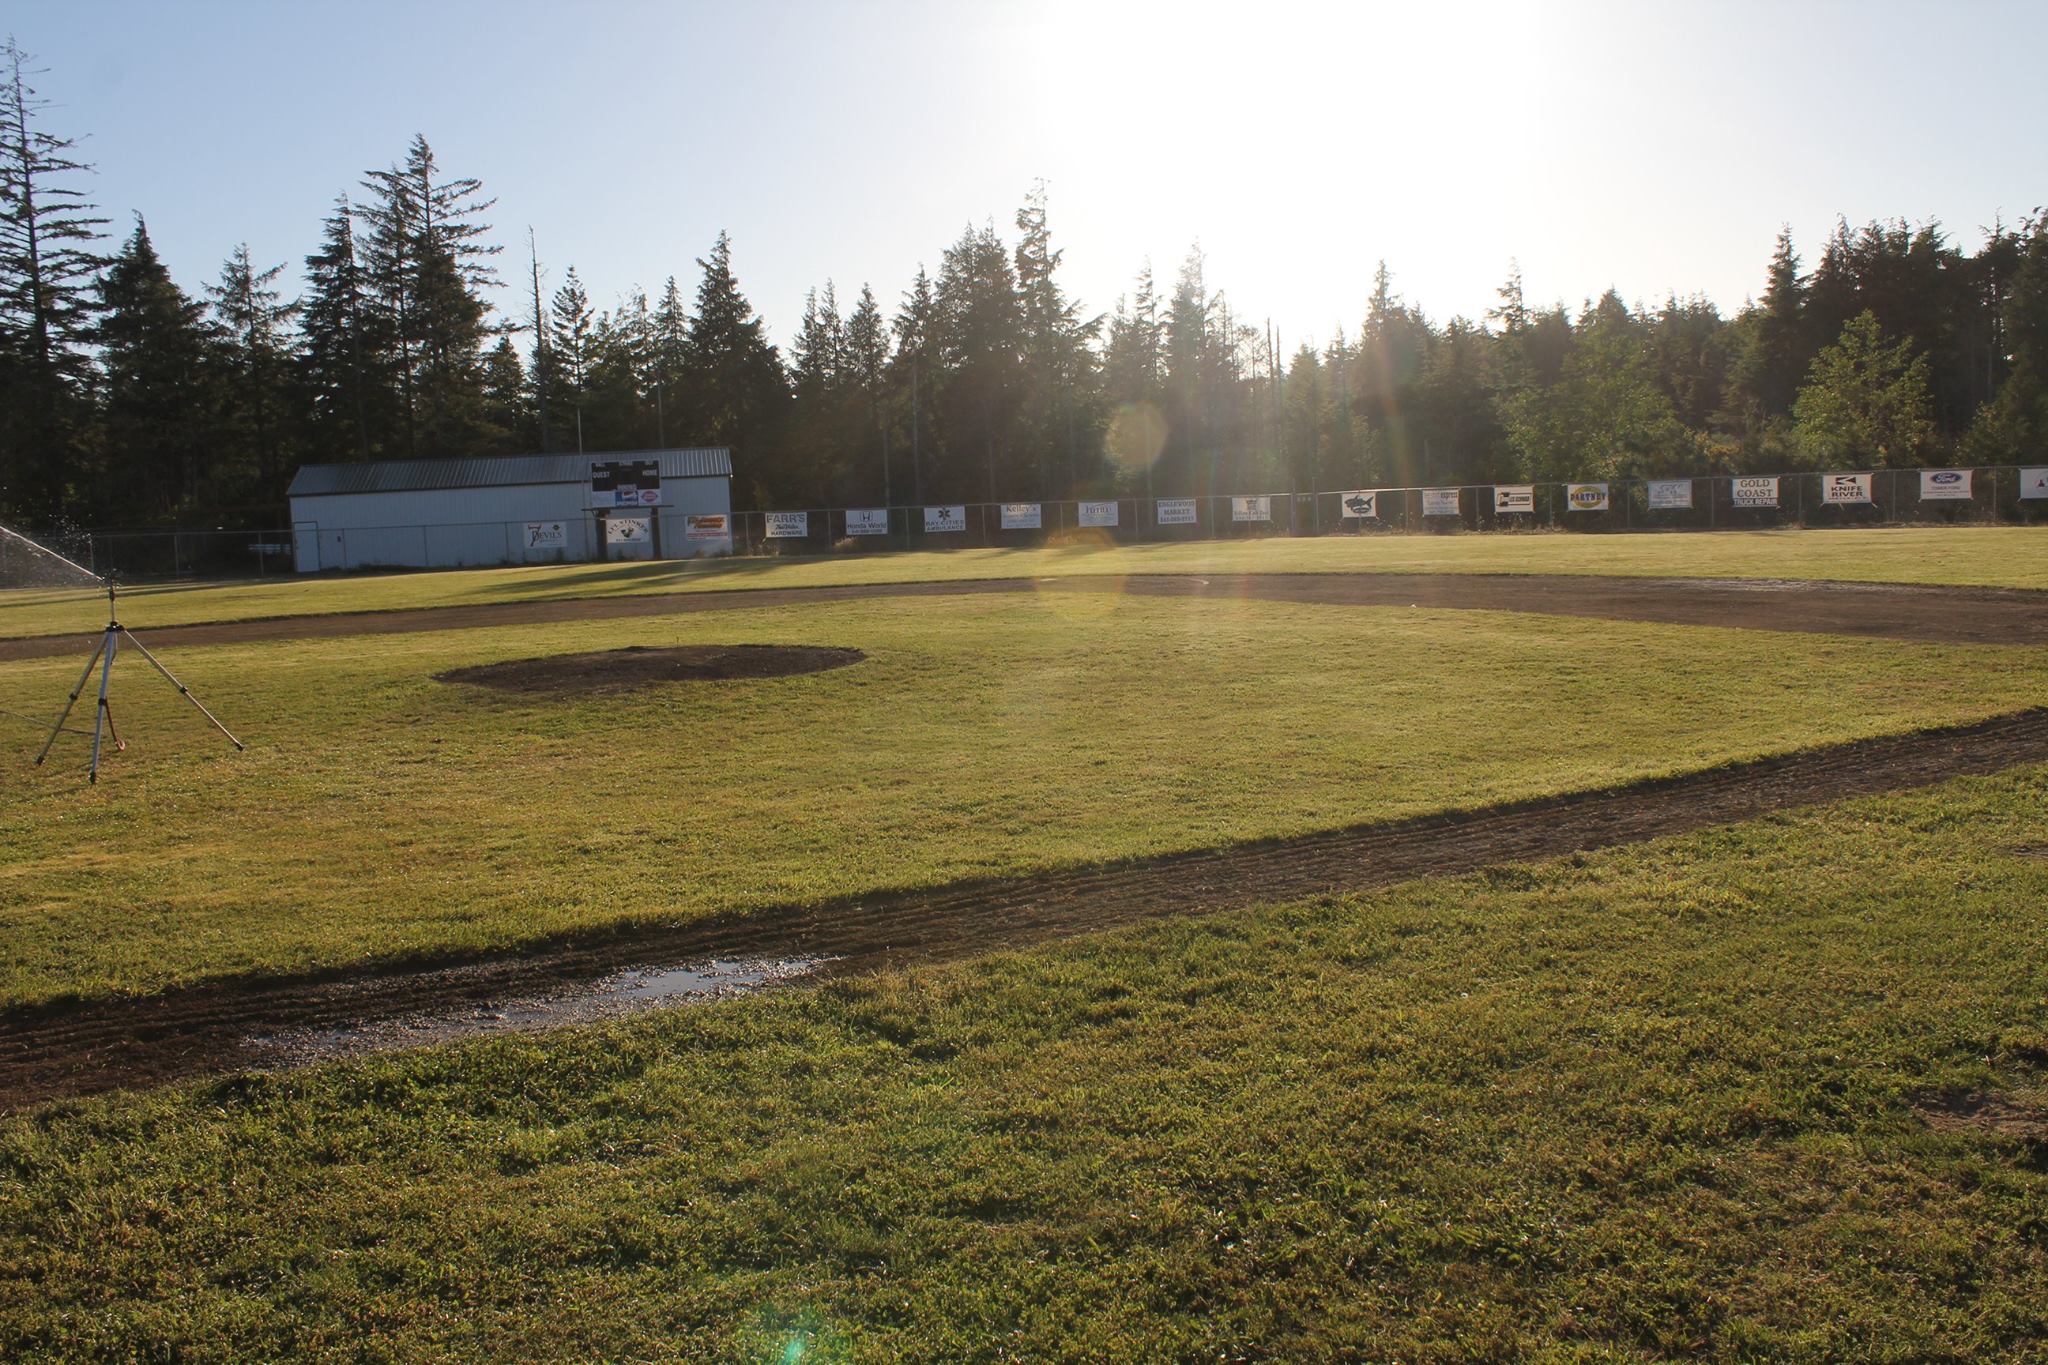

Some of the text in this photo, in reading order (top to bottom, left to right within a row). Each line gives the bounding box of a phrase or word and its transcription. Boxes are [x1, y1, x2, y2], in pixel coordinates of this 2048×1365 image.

[1740, 479, 1770, 488] GOLD
[1737, 489, 1773, 498] COAST
[766, 513, 806, 524] FARR'S
[868, 521, 887, 529] World
